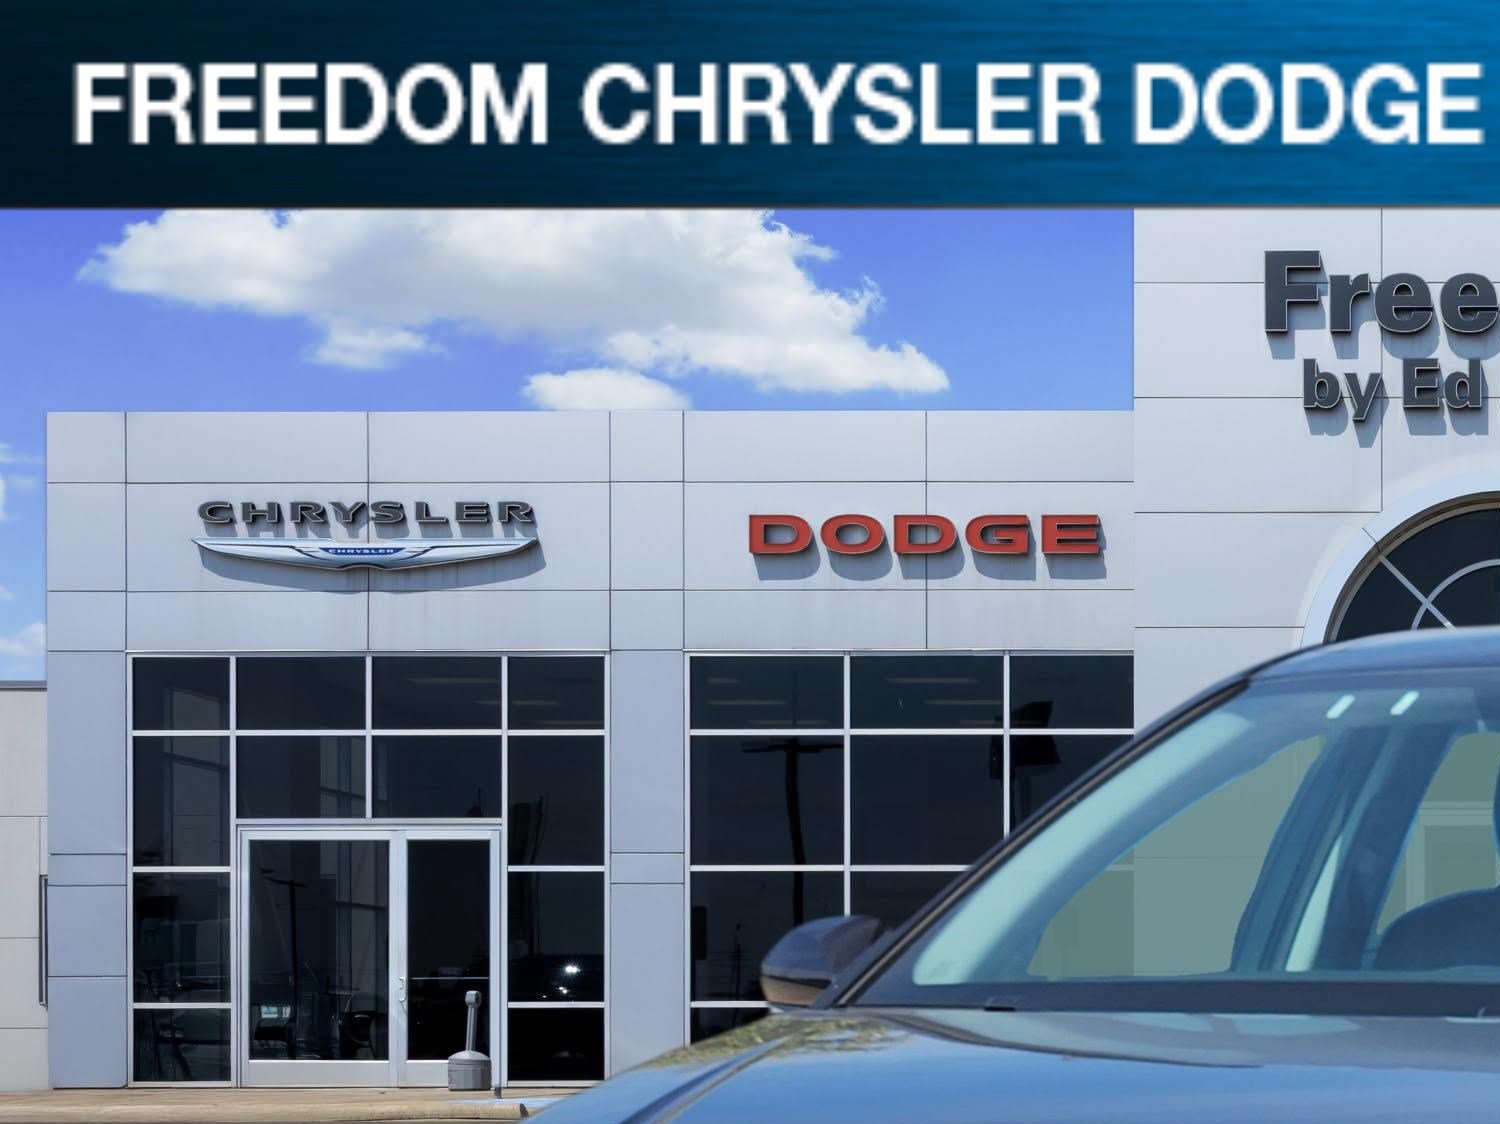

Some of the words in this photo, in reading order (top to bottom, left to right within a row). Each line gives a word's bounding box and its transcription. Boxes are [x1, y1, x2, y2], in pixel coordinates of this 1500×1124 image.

[1303, 358, 1383, 421] by
[1402, 358, 1483, 408] Ed
[198, 500, 534, 525] CHRYSLER
[748, 513, 1101, 555] DODGE
